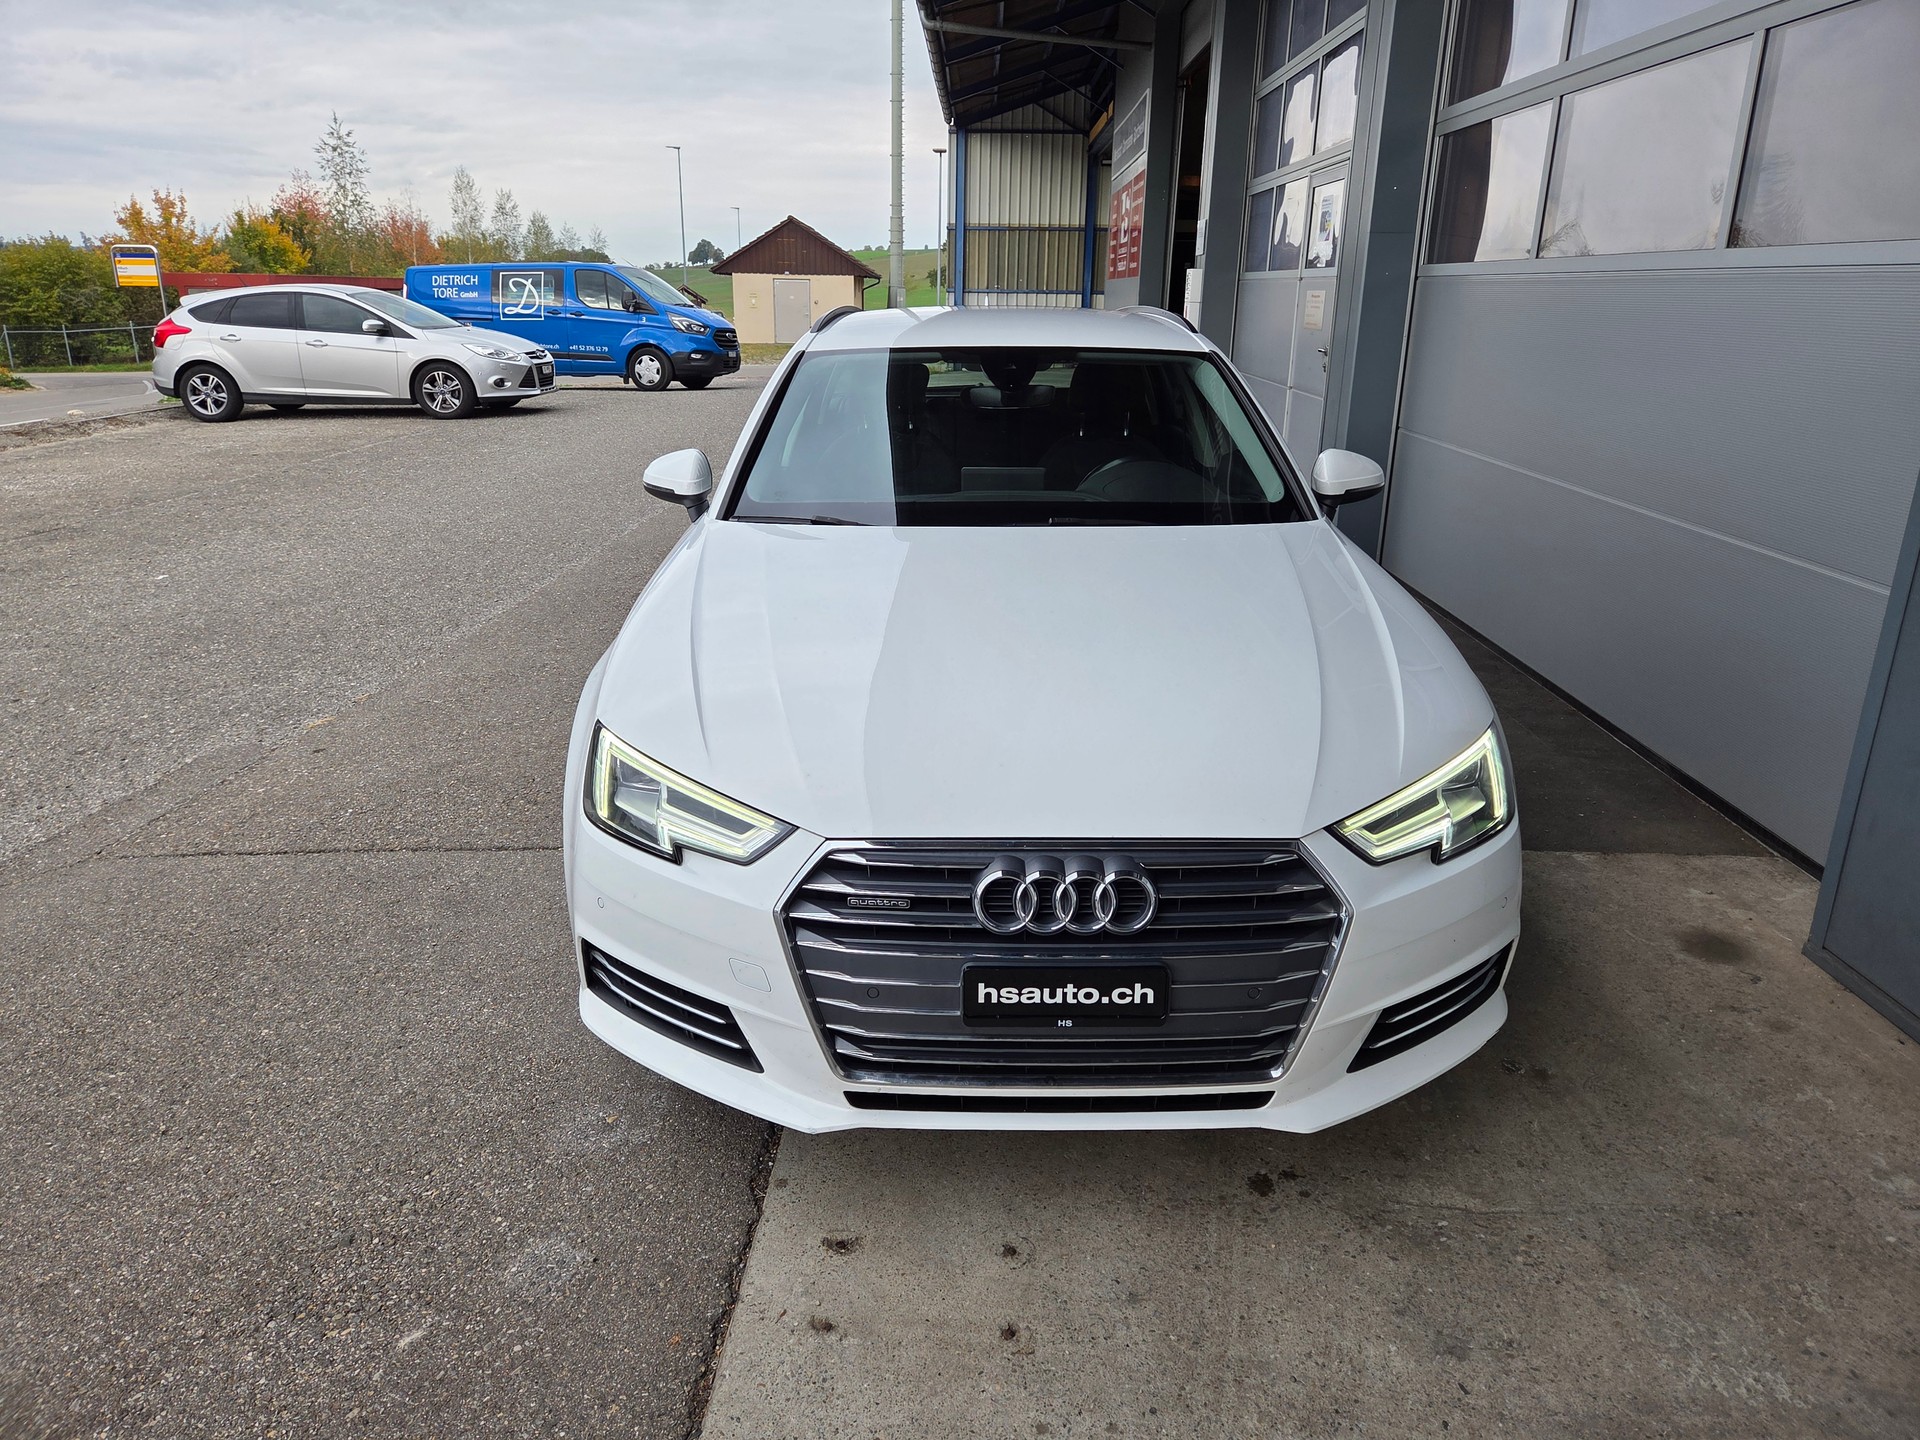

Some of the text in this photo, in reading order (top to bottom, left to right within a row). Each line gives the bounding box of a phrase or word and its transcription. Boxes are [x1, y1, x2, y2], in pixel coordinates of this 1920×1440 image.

[432, 275, 478, 286] DIETRICH
[433, 288, 458, 298] TORE
[850, 899, 907, 907] quattro
[977, 982, 1154, 1004] hsauto.ch
[1058, 1019, 1073, 1027] HS
